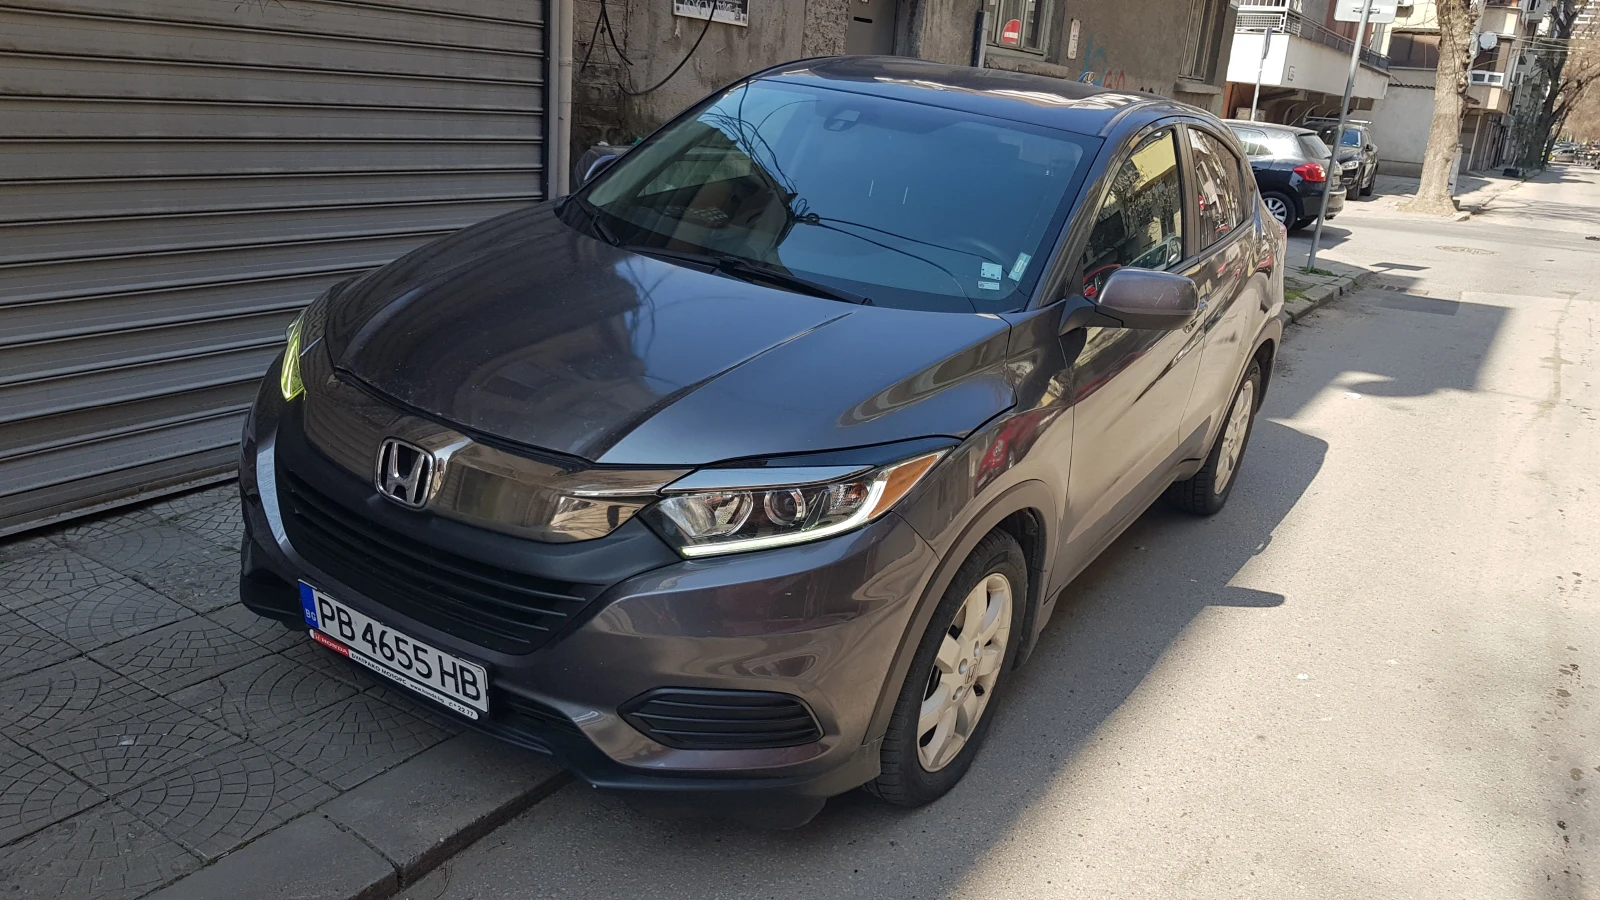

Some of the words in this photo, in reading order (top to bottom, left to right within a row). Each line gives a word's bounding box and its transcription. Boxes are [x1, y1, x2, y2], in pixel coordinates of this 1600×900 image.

[305, 608, 317, 622] BG
[318, 596, 356, 642] PB
[362, 622, 433, 680] 4655
[438, 655, 481, 701] HB
[321, 638, 348, 655] HONDA
